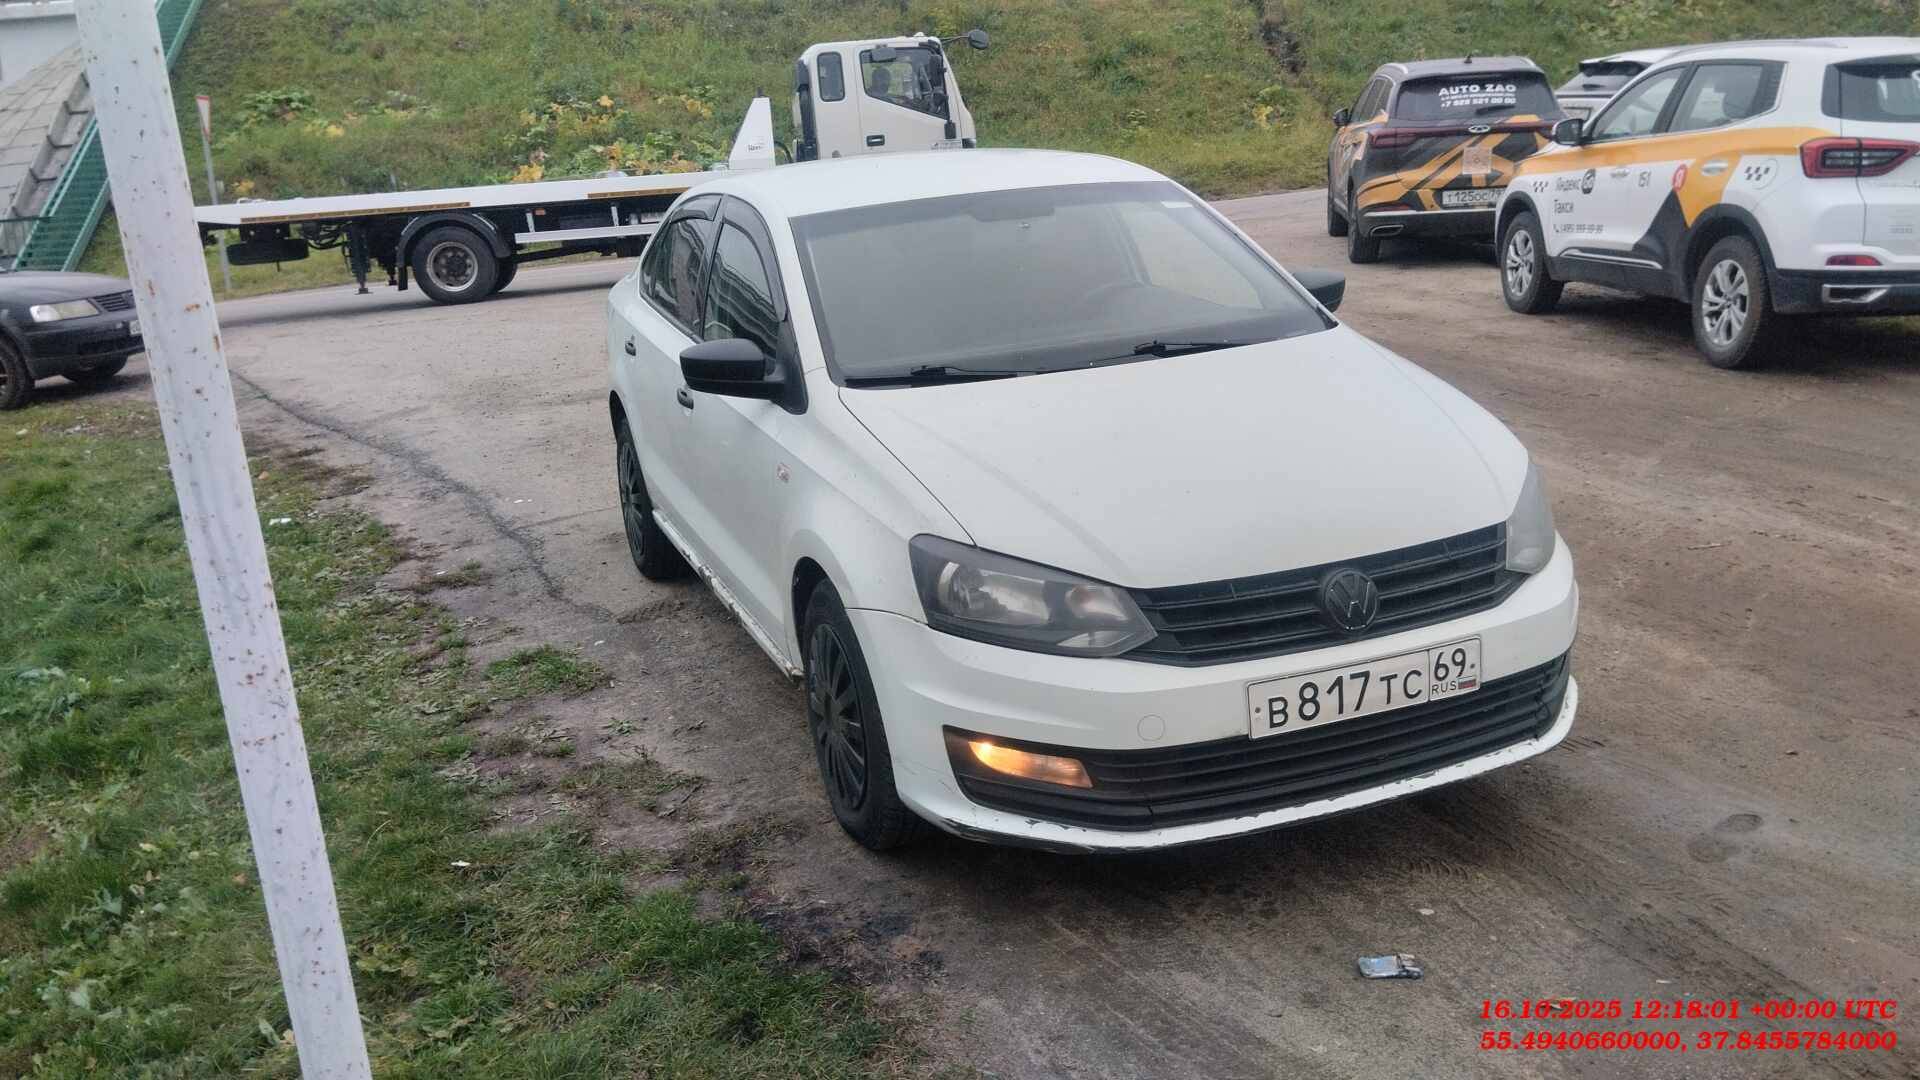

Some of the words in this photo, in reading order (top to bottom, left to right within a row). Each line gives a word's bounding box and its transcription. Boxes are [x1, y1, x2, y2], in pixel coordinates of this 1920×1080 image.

[1439, 85, 1480, 96] AUTO
[1485, 84, 1516, 93] ZAO
[1433, 647, 1467, 682] 69
[1431, 680, 1457, 696] RUS
